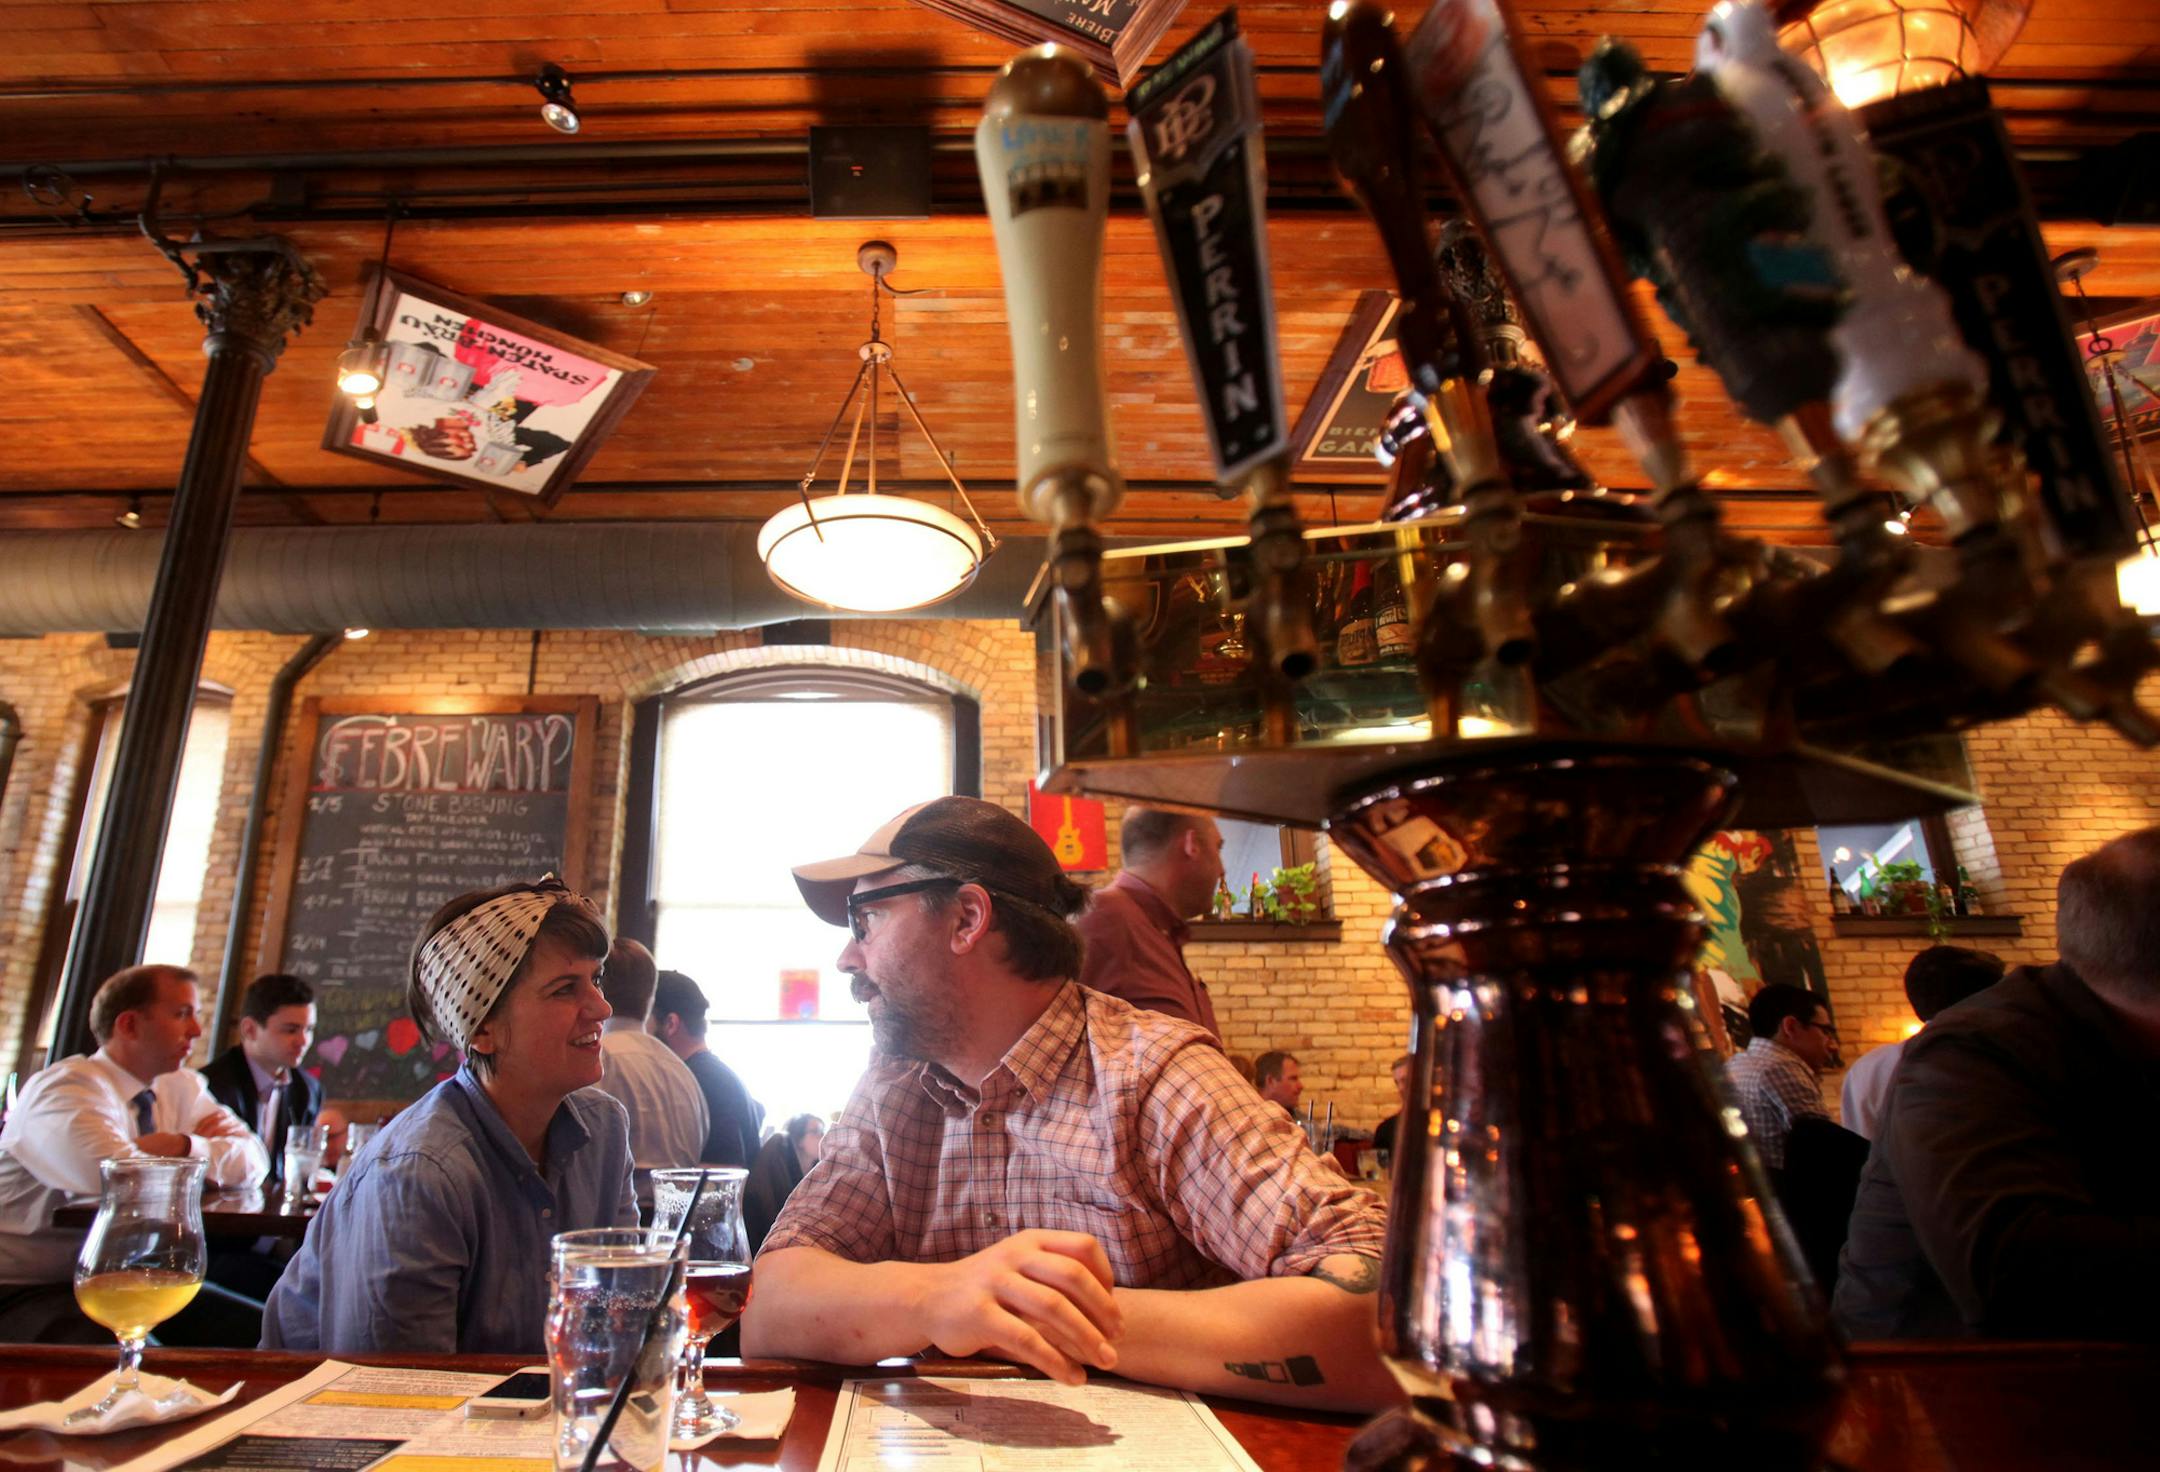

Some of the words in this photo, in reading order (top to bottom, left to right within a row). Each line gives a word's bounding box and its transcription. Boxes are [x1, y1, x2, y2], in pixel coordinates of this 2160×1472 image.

[1065, 12, 1115, 43] BIERE
[1190, 194, 1260, 420] PERRIN
[400, 314, 590, 386] SPATEN-BRÄU
[319, 714, 574, 792] FEBREWARY
[372, 793, 440, 813] STONE
[451, 796, 529, 816] BREWING
[429, 814, 488, 825] TAKEOVER
